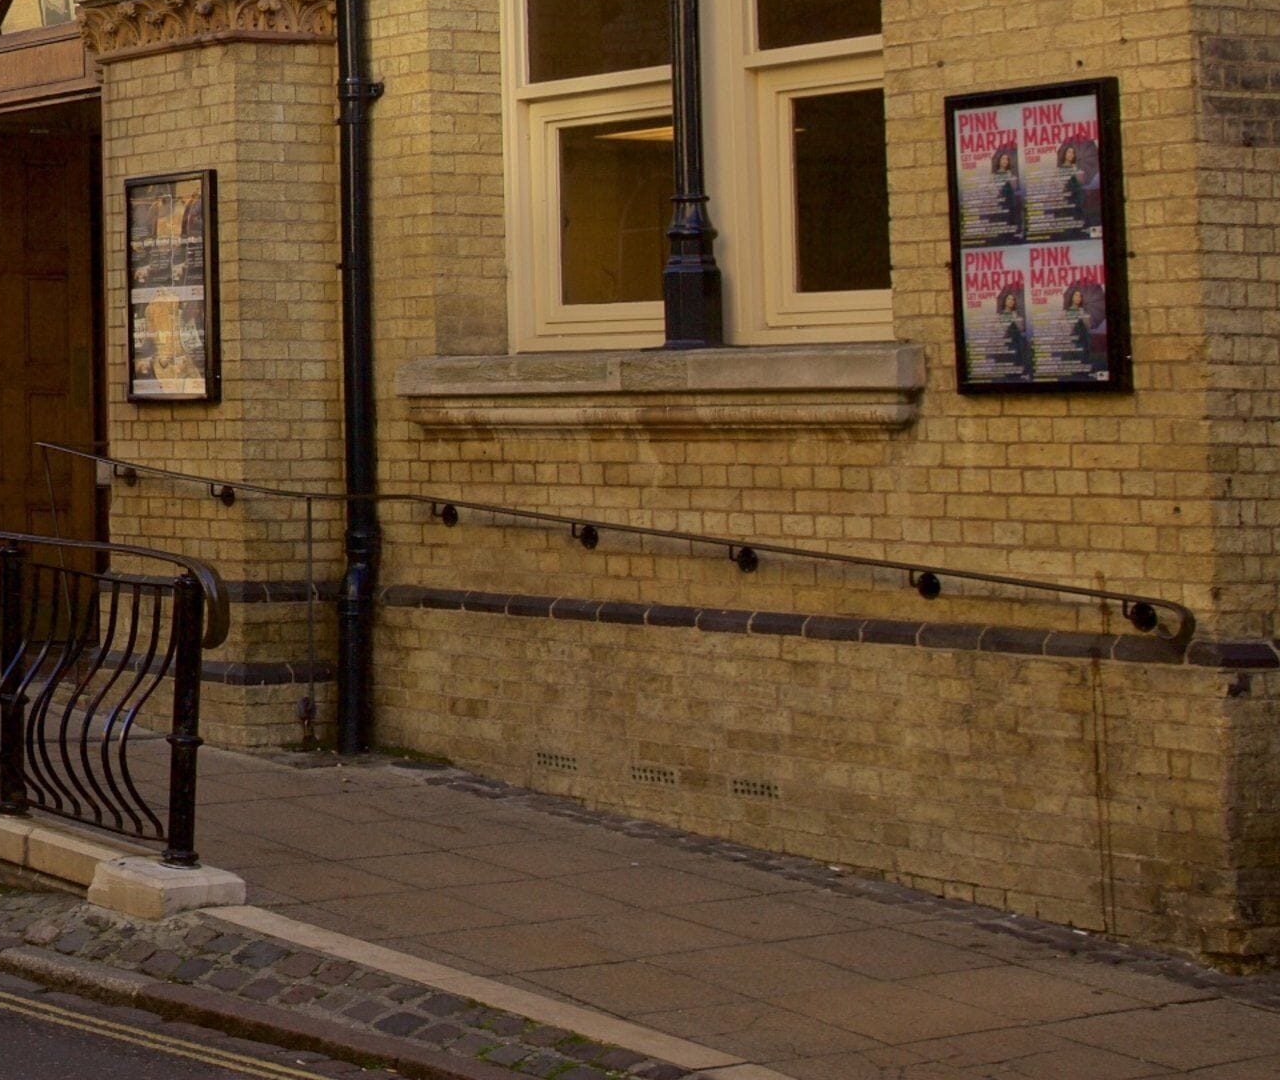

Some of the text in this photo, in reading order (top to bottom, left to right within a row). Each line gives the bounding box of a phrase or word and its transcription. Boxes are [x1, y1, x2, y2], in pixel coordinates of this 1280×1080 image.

[958, 110, 998, 133] PINK
[1022, 103, 1063, 126] PINK
[1023, 120, 1099, 147] MARTINI
[1024, 146, 1057, 156] GET HAPPY
[965, 251, 1004, 272] PINK
[1030, 246, 1071, 267] PINK
[1031, 264, 1106, 288] MARTINI
[1031, 288, 1064, 297] GET HAPPY
